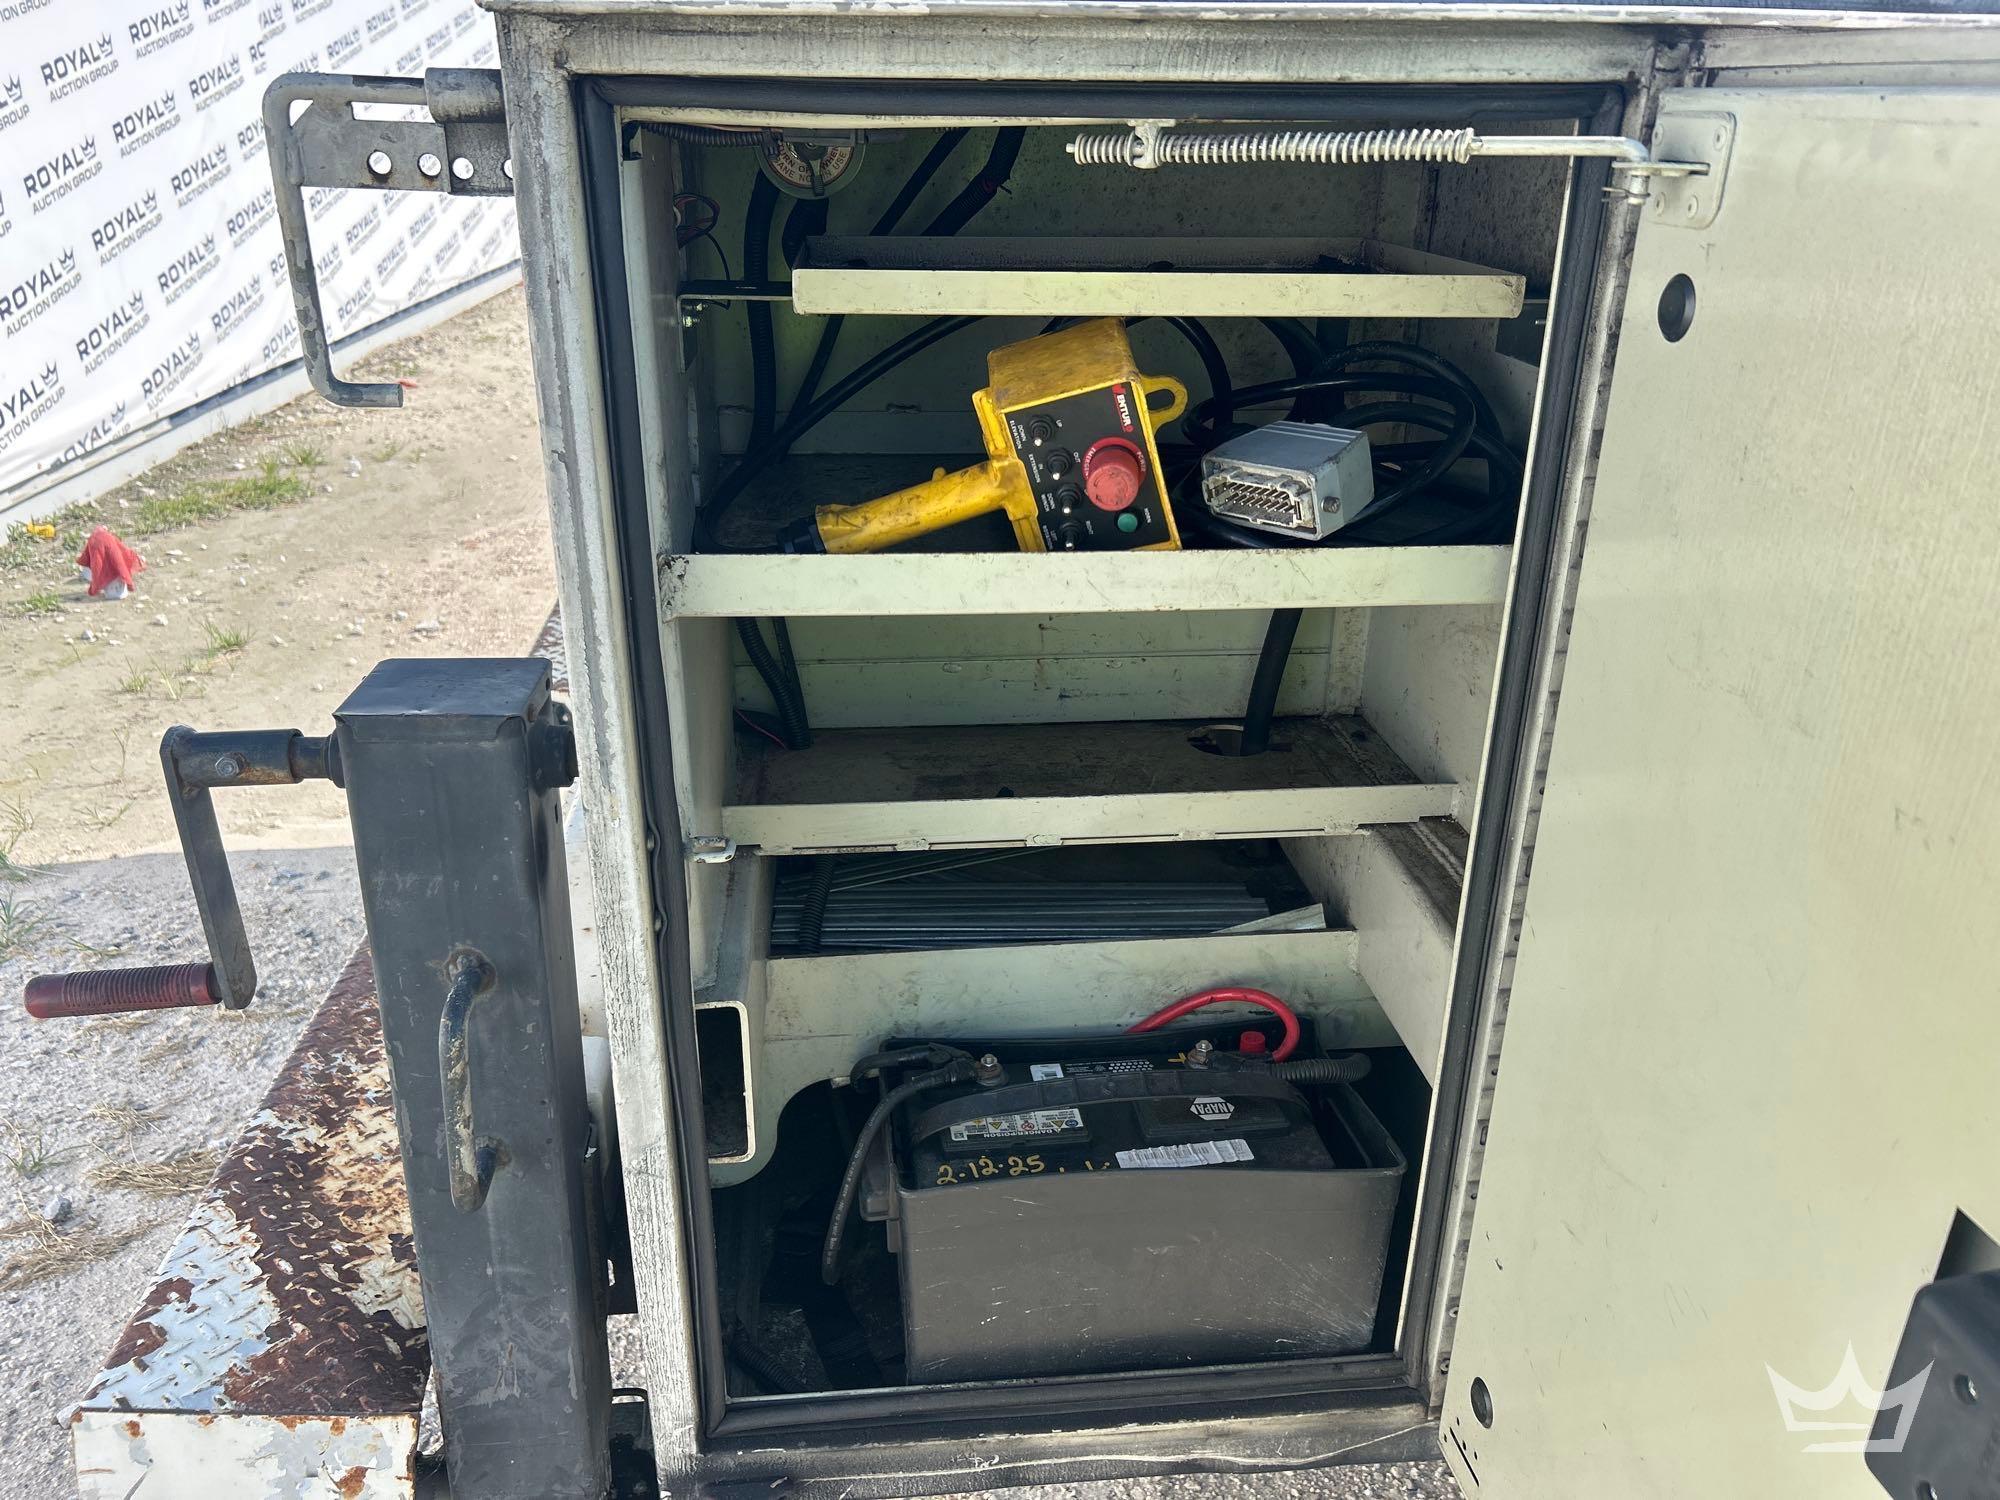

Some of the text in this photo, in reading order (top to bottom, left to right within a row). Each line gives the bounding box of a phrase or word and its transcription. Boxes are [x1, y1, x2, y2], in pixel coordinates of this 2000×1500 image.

[129, 8, 179, 44] ROYAL
[136, 23, 194, 59] AUCTION GROUP
[41, 43, 101, 86] ROYAL
[50, 60, 119, 103] AUCTION GROUP
[189, 62, 232, 99] ROYAL
[112, 100, 165, 143] ROYAL
[119, 113, 181, 158] AUCTION GROUP
[23, 148, 84, 198] ROYAL
[171, 153, 217, 195] ROYAL
[832, 152, 847, 170] USE
[33, 161, 103, 215] AUCTION GROUP
[91, 202, 146, 251] ROYAL
[227, 196, 264, 237] ROYAL
[100, 213, 163, 267] AUCTION GROUP
[157, 245, 205, 293] ROYAL
[0, 262, 62, 321] ROYAL
[6, 272, 82, 338] AUCTION GROUP
[211, 286, 252, 332] ROYAL
[76, 305, 132, 361] ROYAL
[84, 313, 150, 376] AUCTION GROUP
[141, 345, 190, 399] ROYAL
[147, 352, 204, 411] AUCTION GROUP
[30, 386, 65, 422] GROUP
[54, 419, 111, 464] OYAL
[1009, 420, 1022, 450] ELEVATION
[1017, 424, 1027, 441] DOWN
[1028, 453, 1041, 483] EXTENSION
[1073, 451, 1081, 463] OUT
[1195, 1102, 1229, 1115] NAPA
